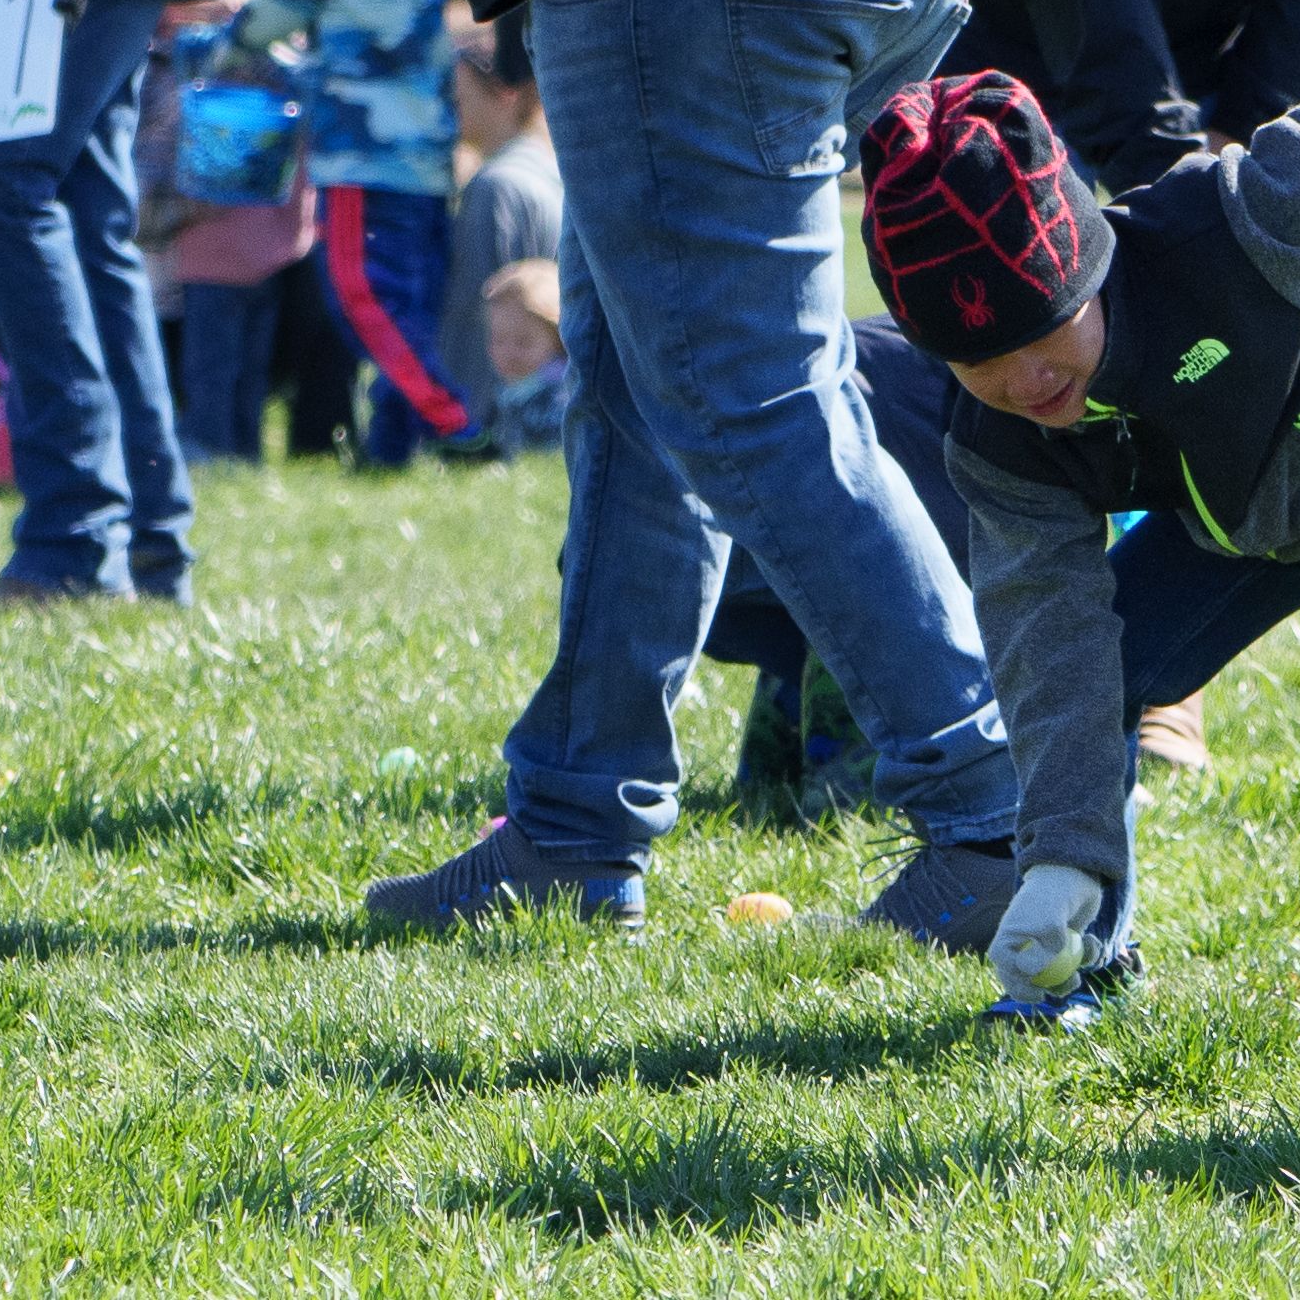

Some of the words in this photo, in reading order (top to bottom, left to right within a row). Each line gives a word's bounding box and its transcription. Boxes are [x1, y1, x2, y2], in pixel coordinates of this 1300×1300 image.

[1180, 345, 1202, 363] THE
[1173, 352, 1210, 383] NORTH
[1188, 360, 1214, 382] FACE
